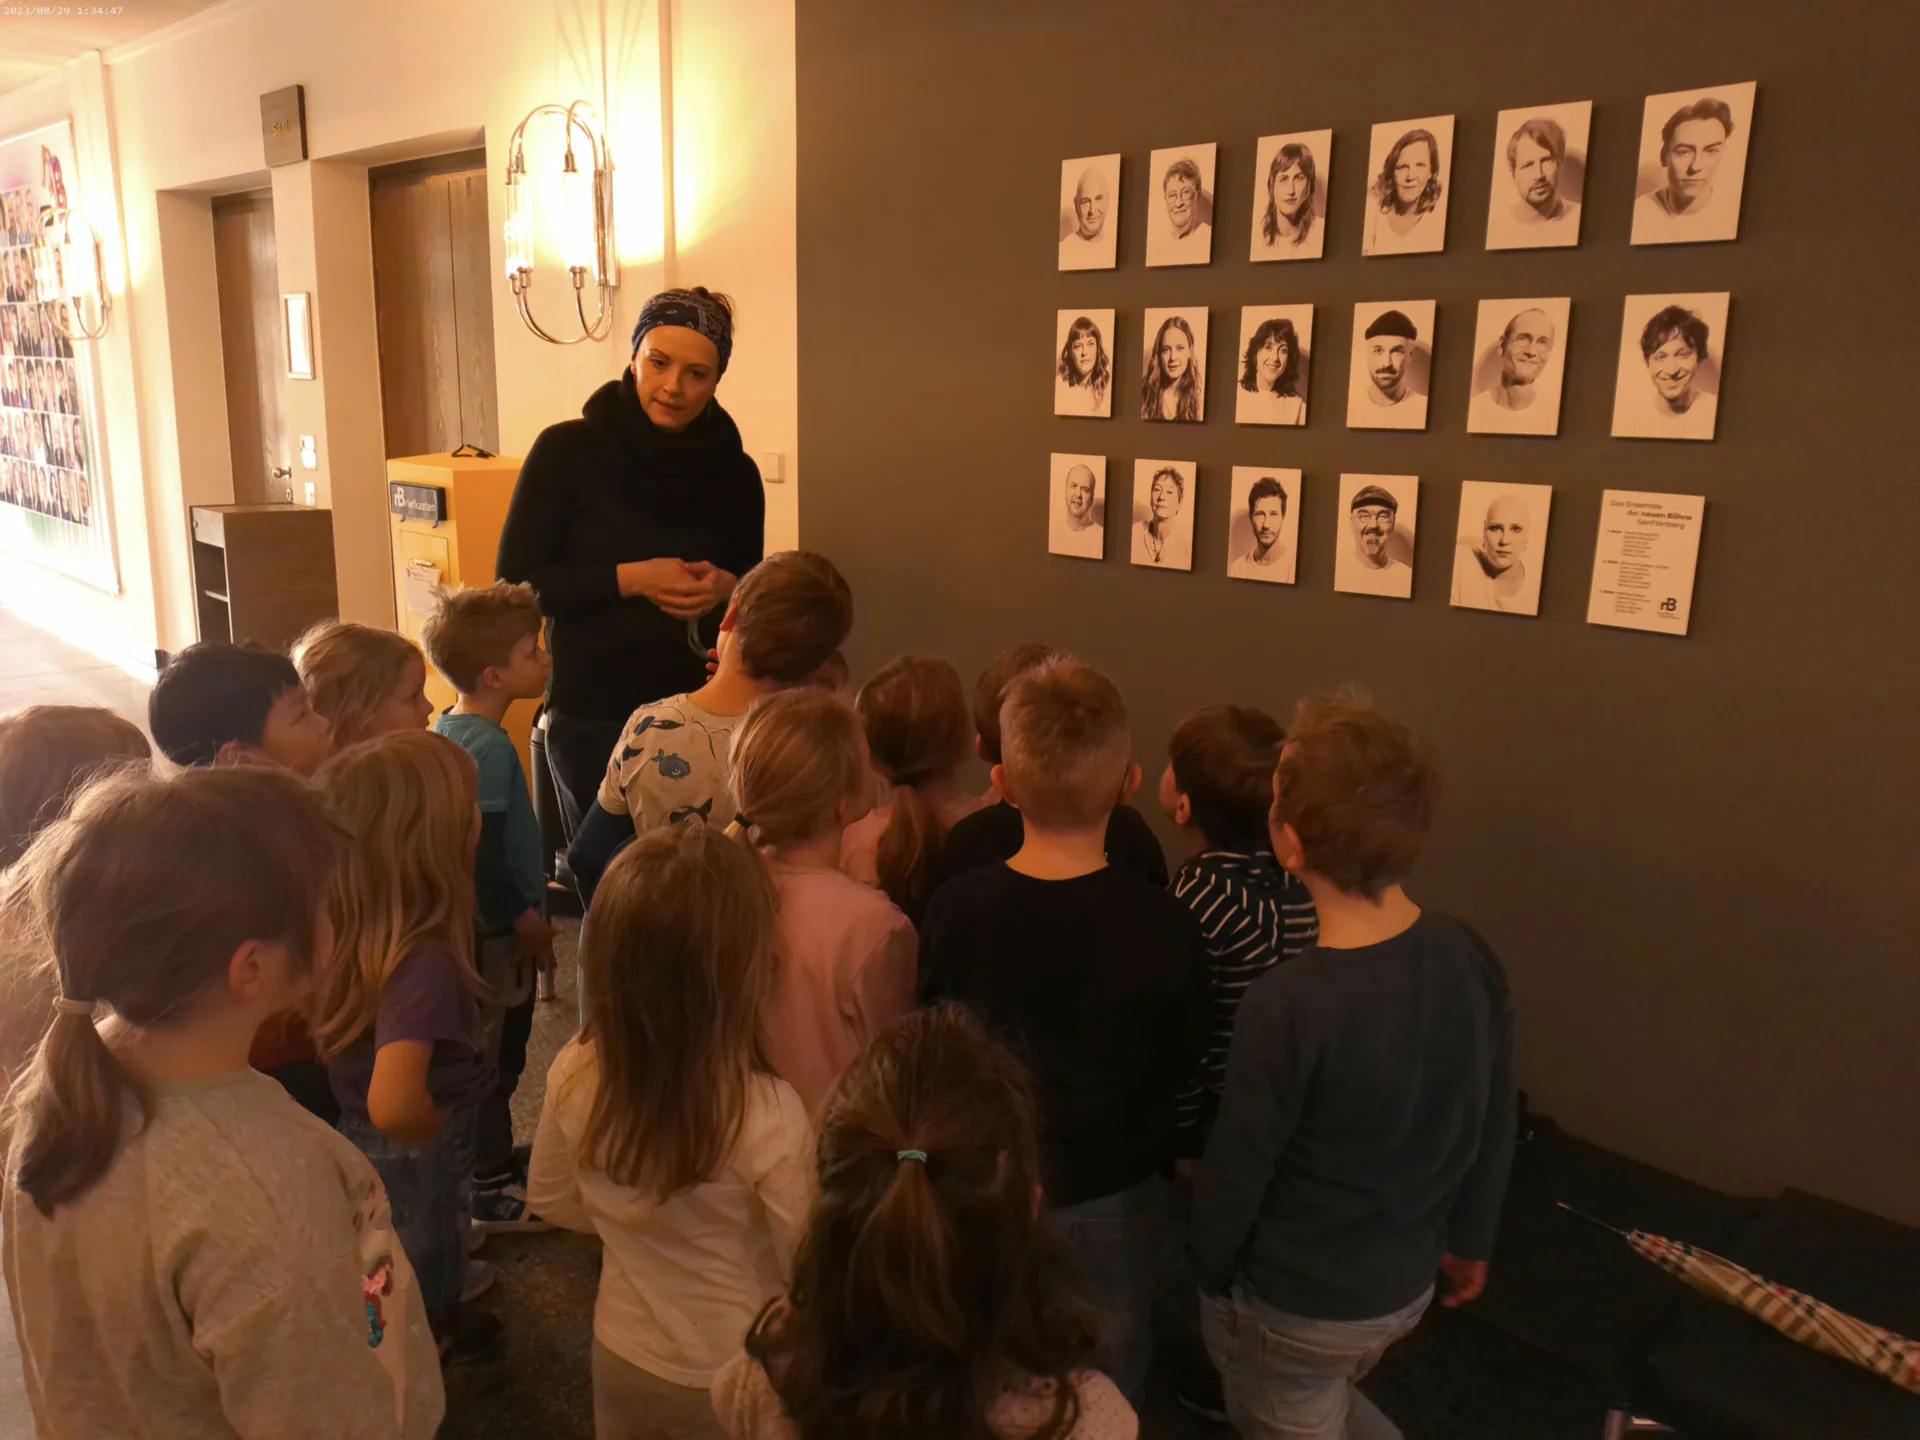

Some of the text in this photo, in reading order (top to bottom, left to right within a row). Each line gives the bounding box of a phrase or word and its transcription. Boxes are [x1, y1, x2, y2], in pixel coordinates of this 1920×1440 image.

[1610, 499, 1663, 510] Das Ensemble
[1667, 513, 1693, 521] Bühne
